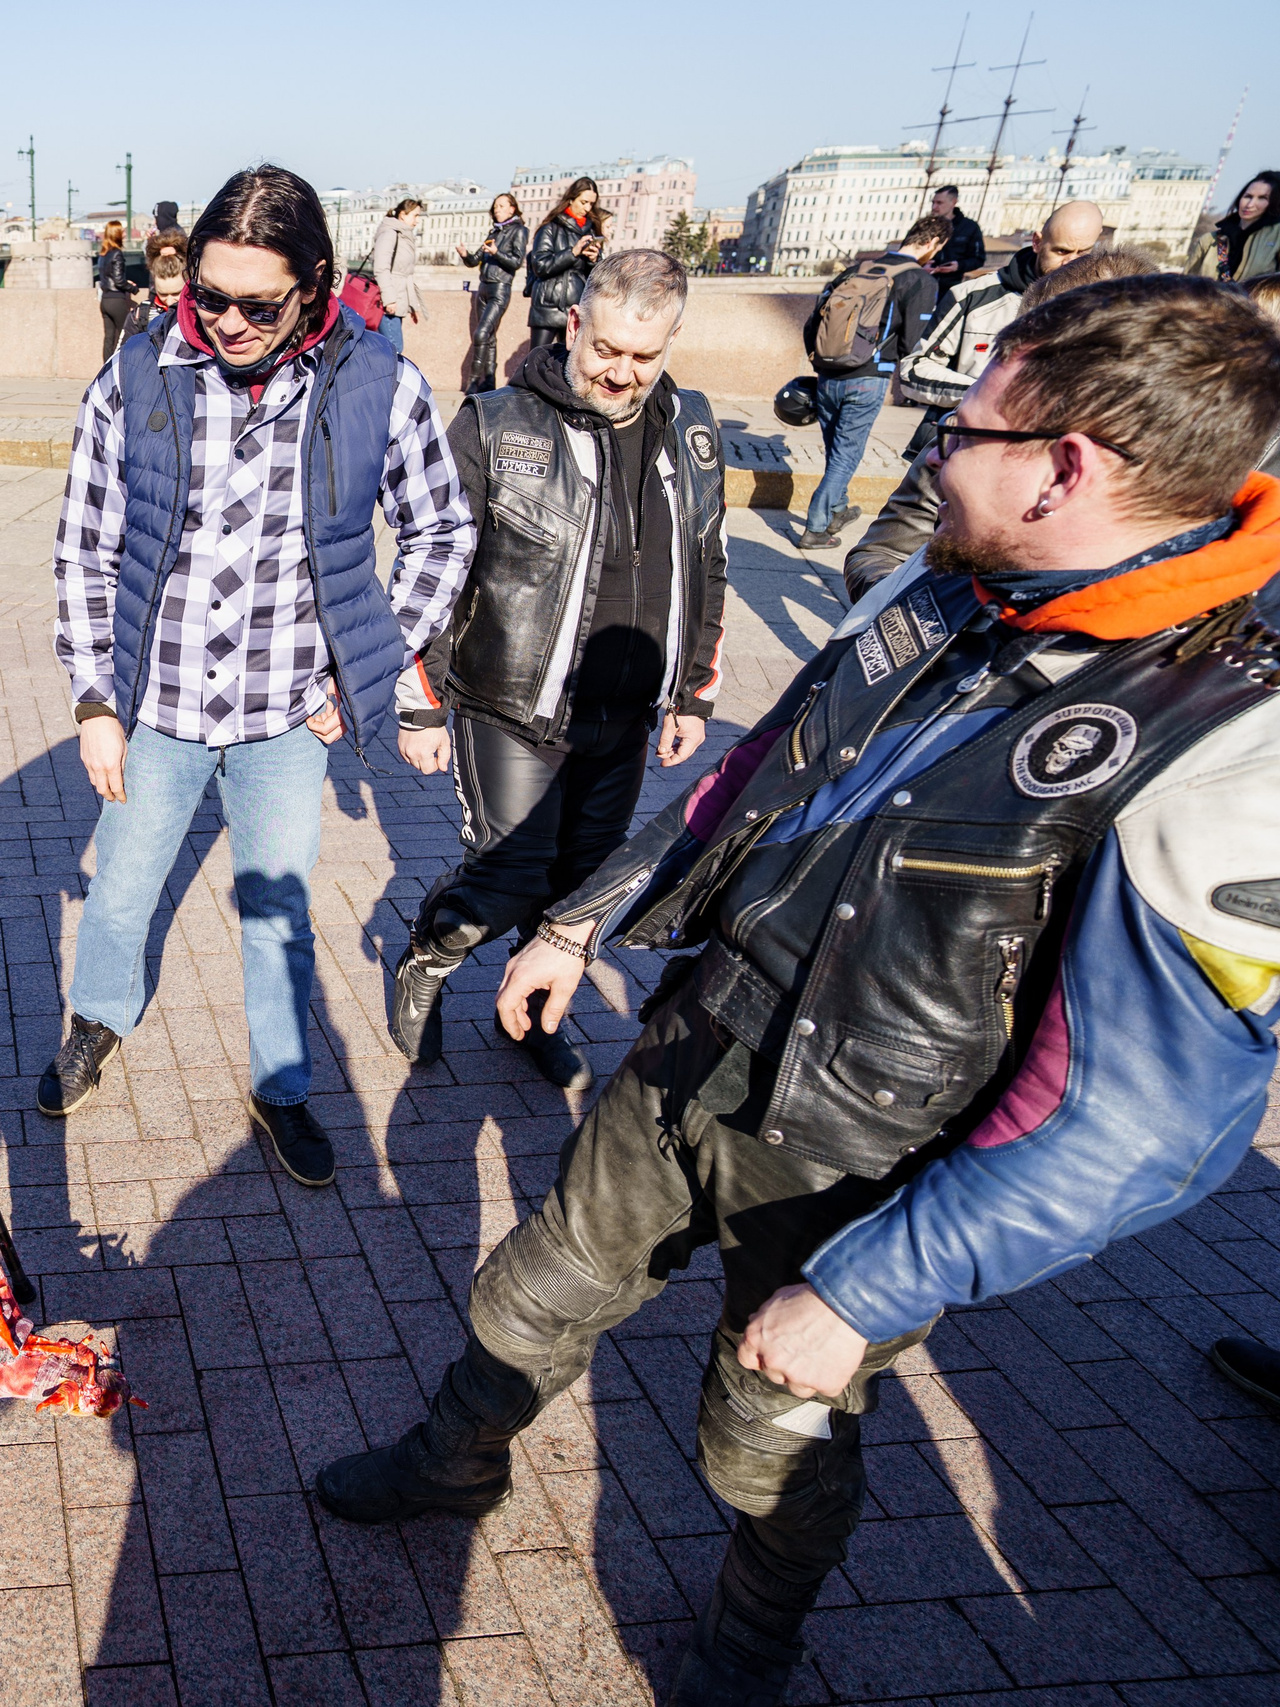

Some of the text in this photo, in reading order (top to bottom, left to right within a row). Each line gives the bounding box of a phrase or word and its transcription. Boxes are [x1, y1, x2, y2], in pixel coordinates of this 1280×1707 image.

[501, 460, 539, 475] MEMBER
[1054, 707, 1133, 738] SUPPORT CLUB
[1016, 756, 1096, 794] THE HOOLIGANS MC
[1225, 893, 1259, 910] Hein
